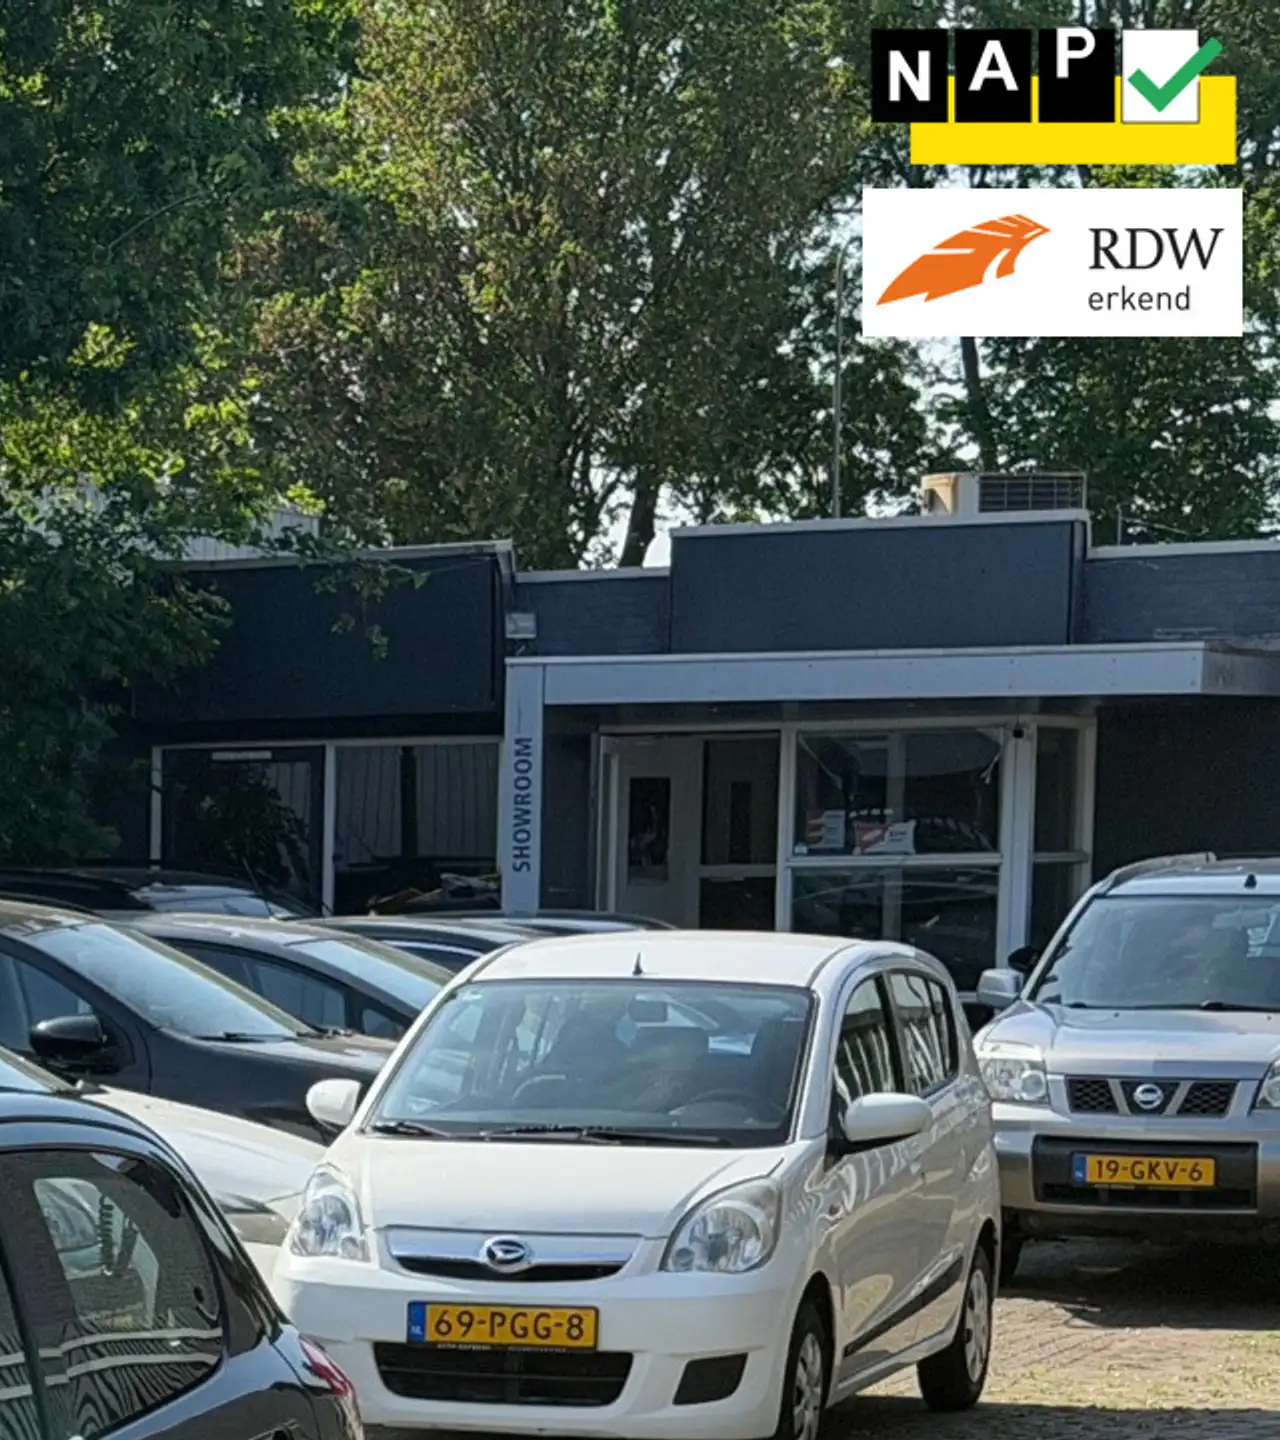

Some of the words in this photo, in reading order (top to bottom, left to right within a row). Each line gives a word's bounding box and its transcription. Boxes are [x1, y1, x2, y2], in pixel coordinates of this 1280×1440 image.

[511, 737, 533, 873] SHOWROOM
[1095, 1159, 1204, 1182] 19-GKV-6
[434, 1310, 584, 1341] 69-PGG-8
